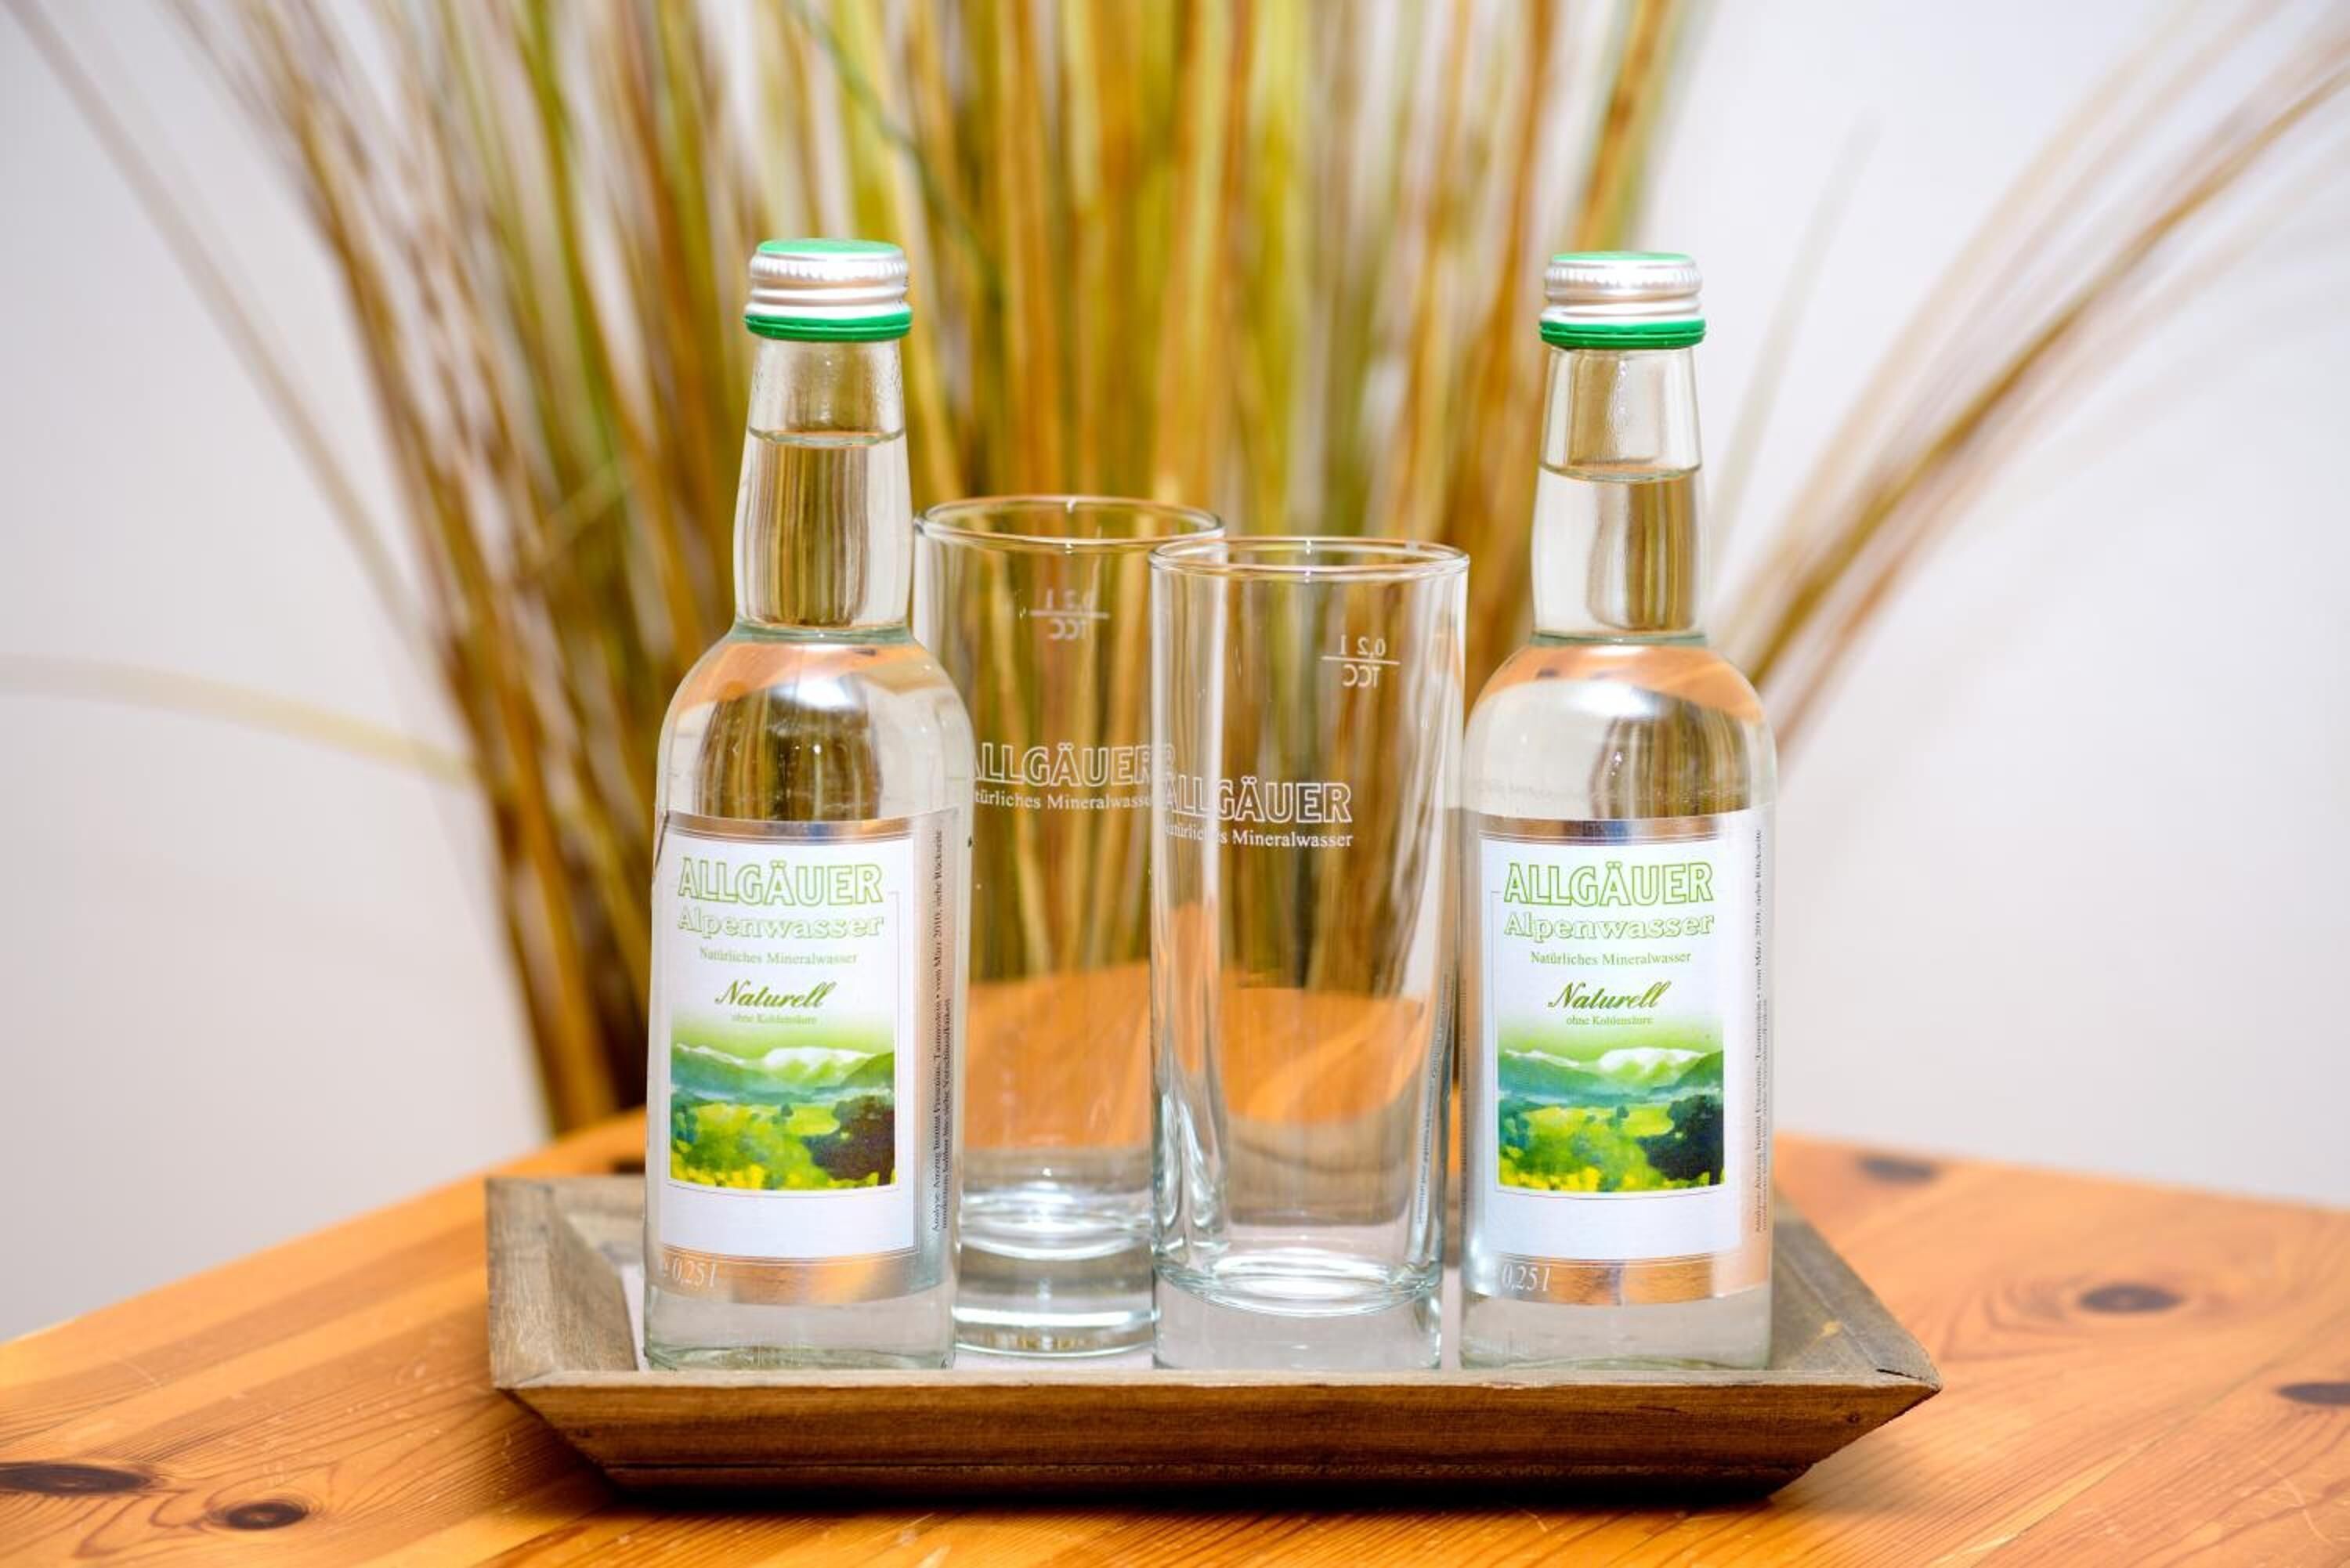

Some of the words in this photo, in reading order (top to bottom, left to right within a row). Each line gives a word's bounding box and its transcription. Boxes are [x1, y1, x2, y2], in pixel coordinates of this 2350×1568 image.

[974, 741, 1175, 787] LLGÄUER
[974, 788, 1041, 810] türliches
[1047, 793, 1152, 811] Mineralwasse
[1232, 828, 1354, 847] Mineralwasser
[678, 857, 884, 906] ALLGÄUER
[1503, 861, 1715, 908] ALLGÄUER
[678, 905, 884, 940] Alpenwasser
[1503, 911, 1715, 943] Alpenwasser
[766, 951, 859, 966] Mineralwasser
[1530, 950, 1598, 966] Natürliches
[1602, 952, 1692, 966] Mineralwasser
[715, 979, 837, 1009] Naturell
[1548, 980, 1672, 1010] Naturell
[1502, 1262, 1538, 1292] 0,25
